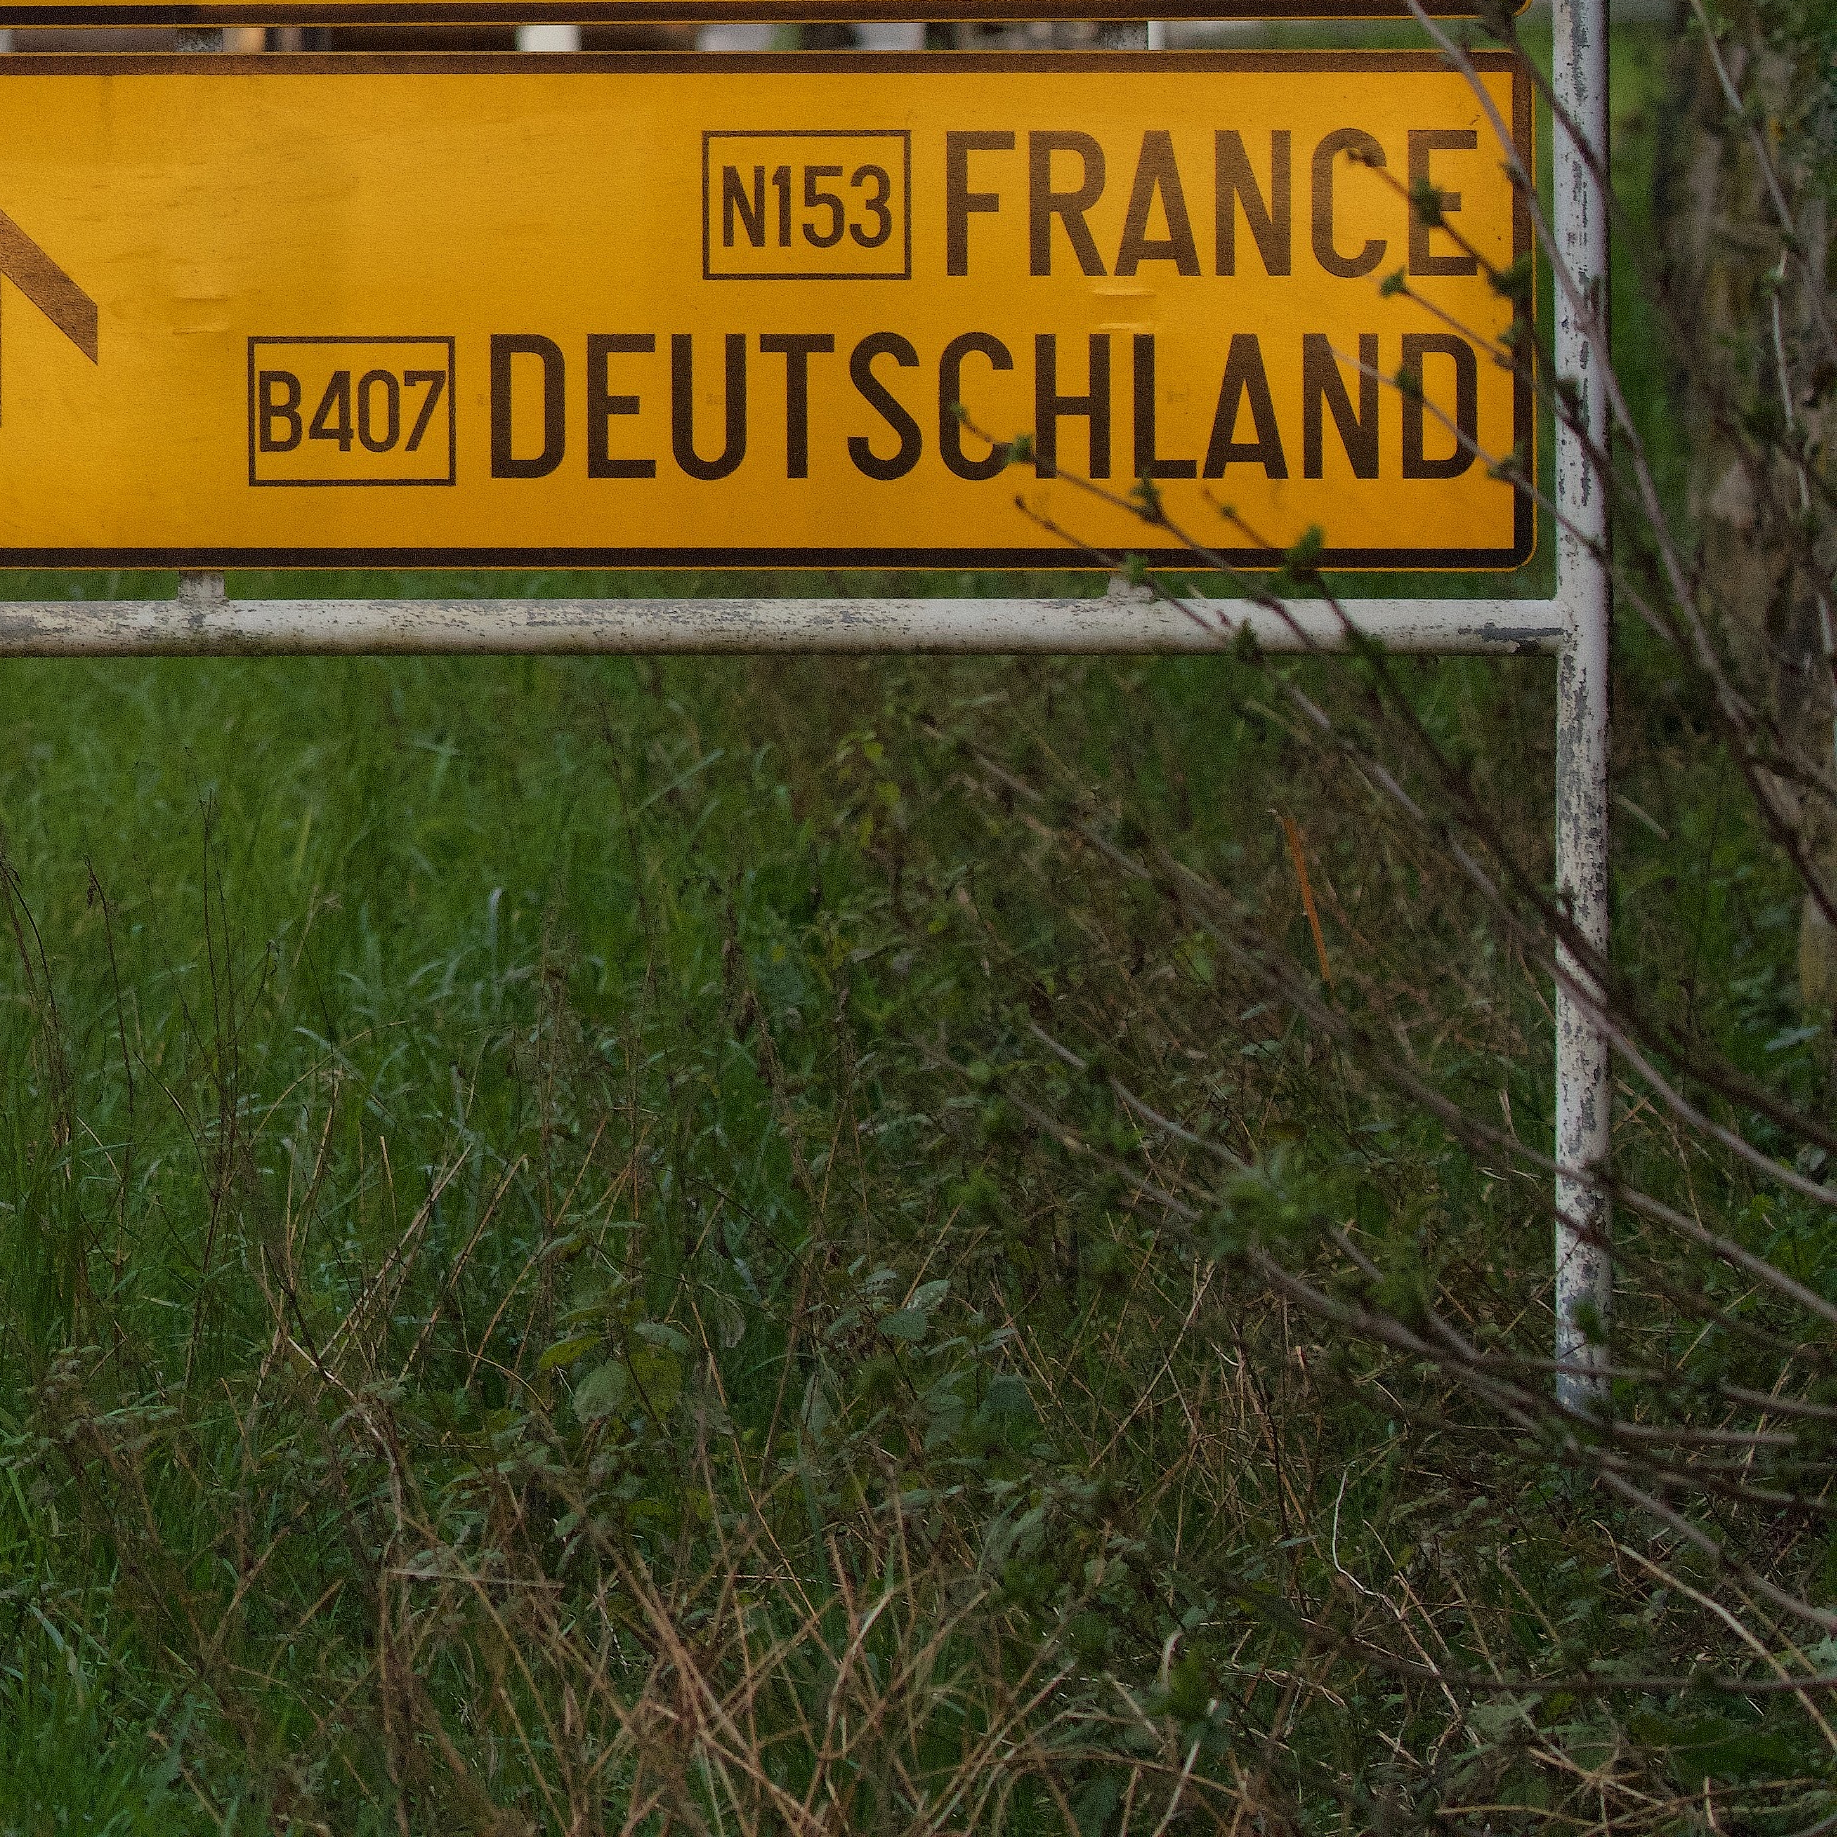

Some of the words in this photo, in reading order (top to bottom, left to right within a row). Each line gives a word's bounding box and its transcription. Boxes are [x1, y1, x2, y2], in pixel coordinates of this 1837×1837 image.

[721, 163, 893, 249] N153
[945, 127, 1478, 278] FRANCE
[258, 369, 447, 453] B407
[490, 332, 1479, 482] DEUTSCHLAND
